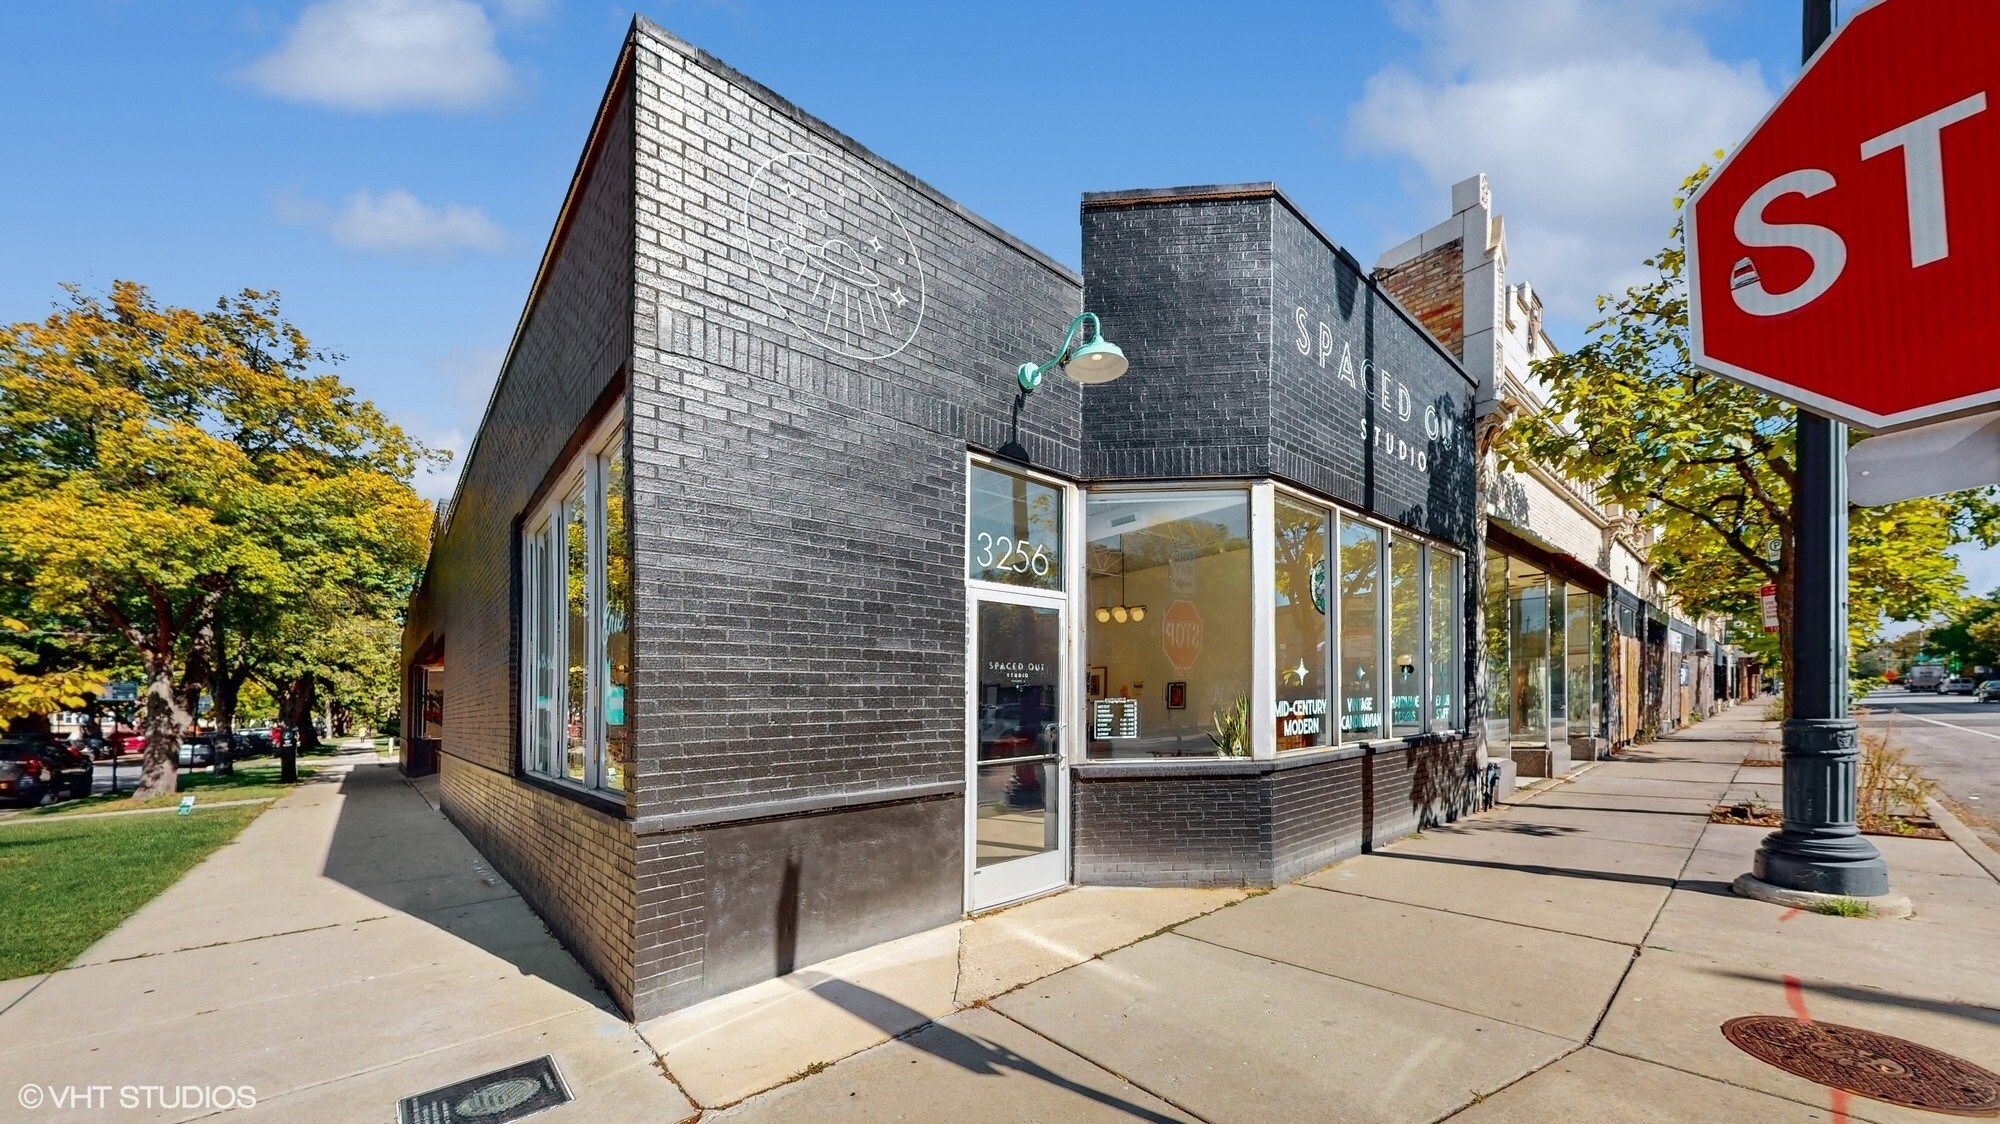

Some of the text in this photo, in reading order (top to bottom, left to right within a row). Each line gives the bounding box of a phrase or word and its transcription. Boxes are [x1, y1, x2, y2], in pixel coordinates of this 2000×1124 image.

[1295, 306, 1412, 422] SPACED
[1360, 418, 1427, 472] STUDIO
[976, 532, 1049, 576] 3256
[989, 661, 1045, 671] SPACED OUT
[1275, 698, 1327, 717] MID-CENTURY
[1347, 697, 1373, 712] VINTAGE
[1284, 718, 1319, 736] MODERN
[1340, 713, 1382, 730] CANDINAVIAN
